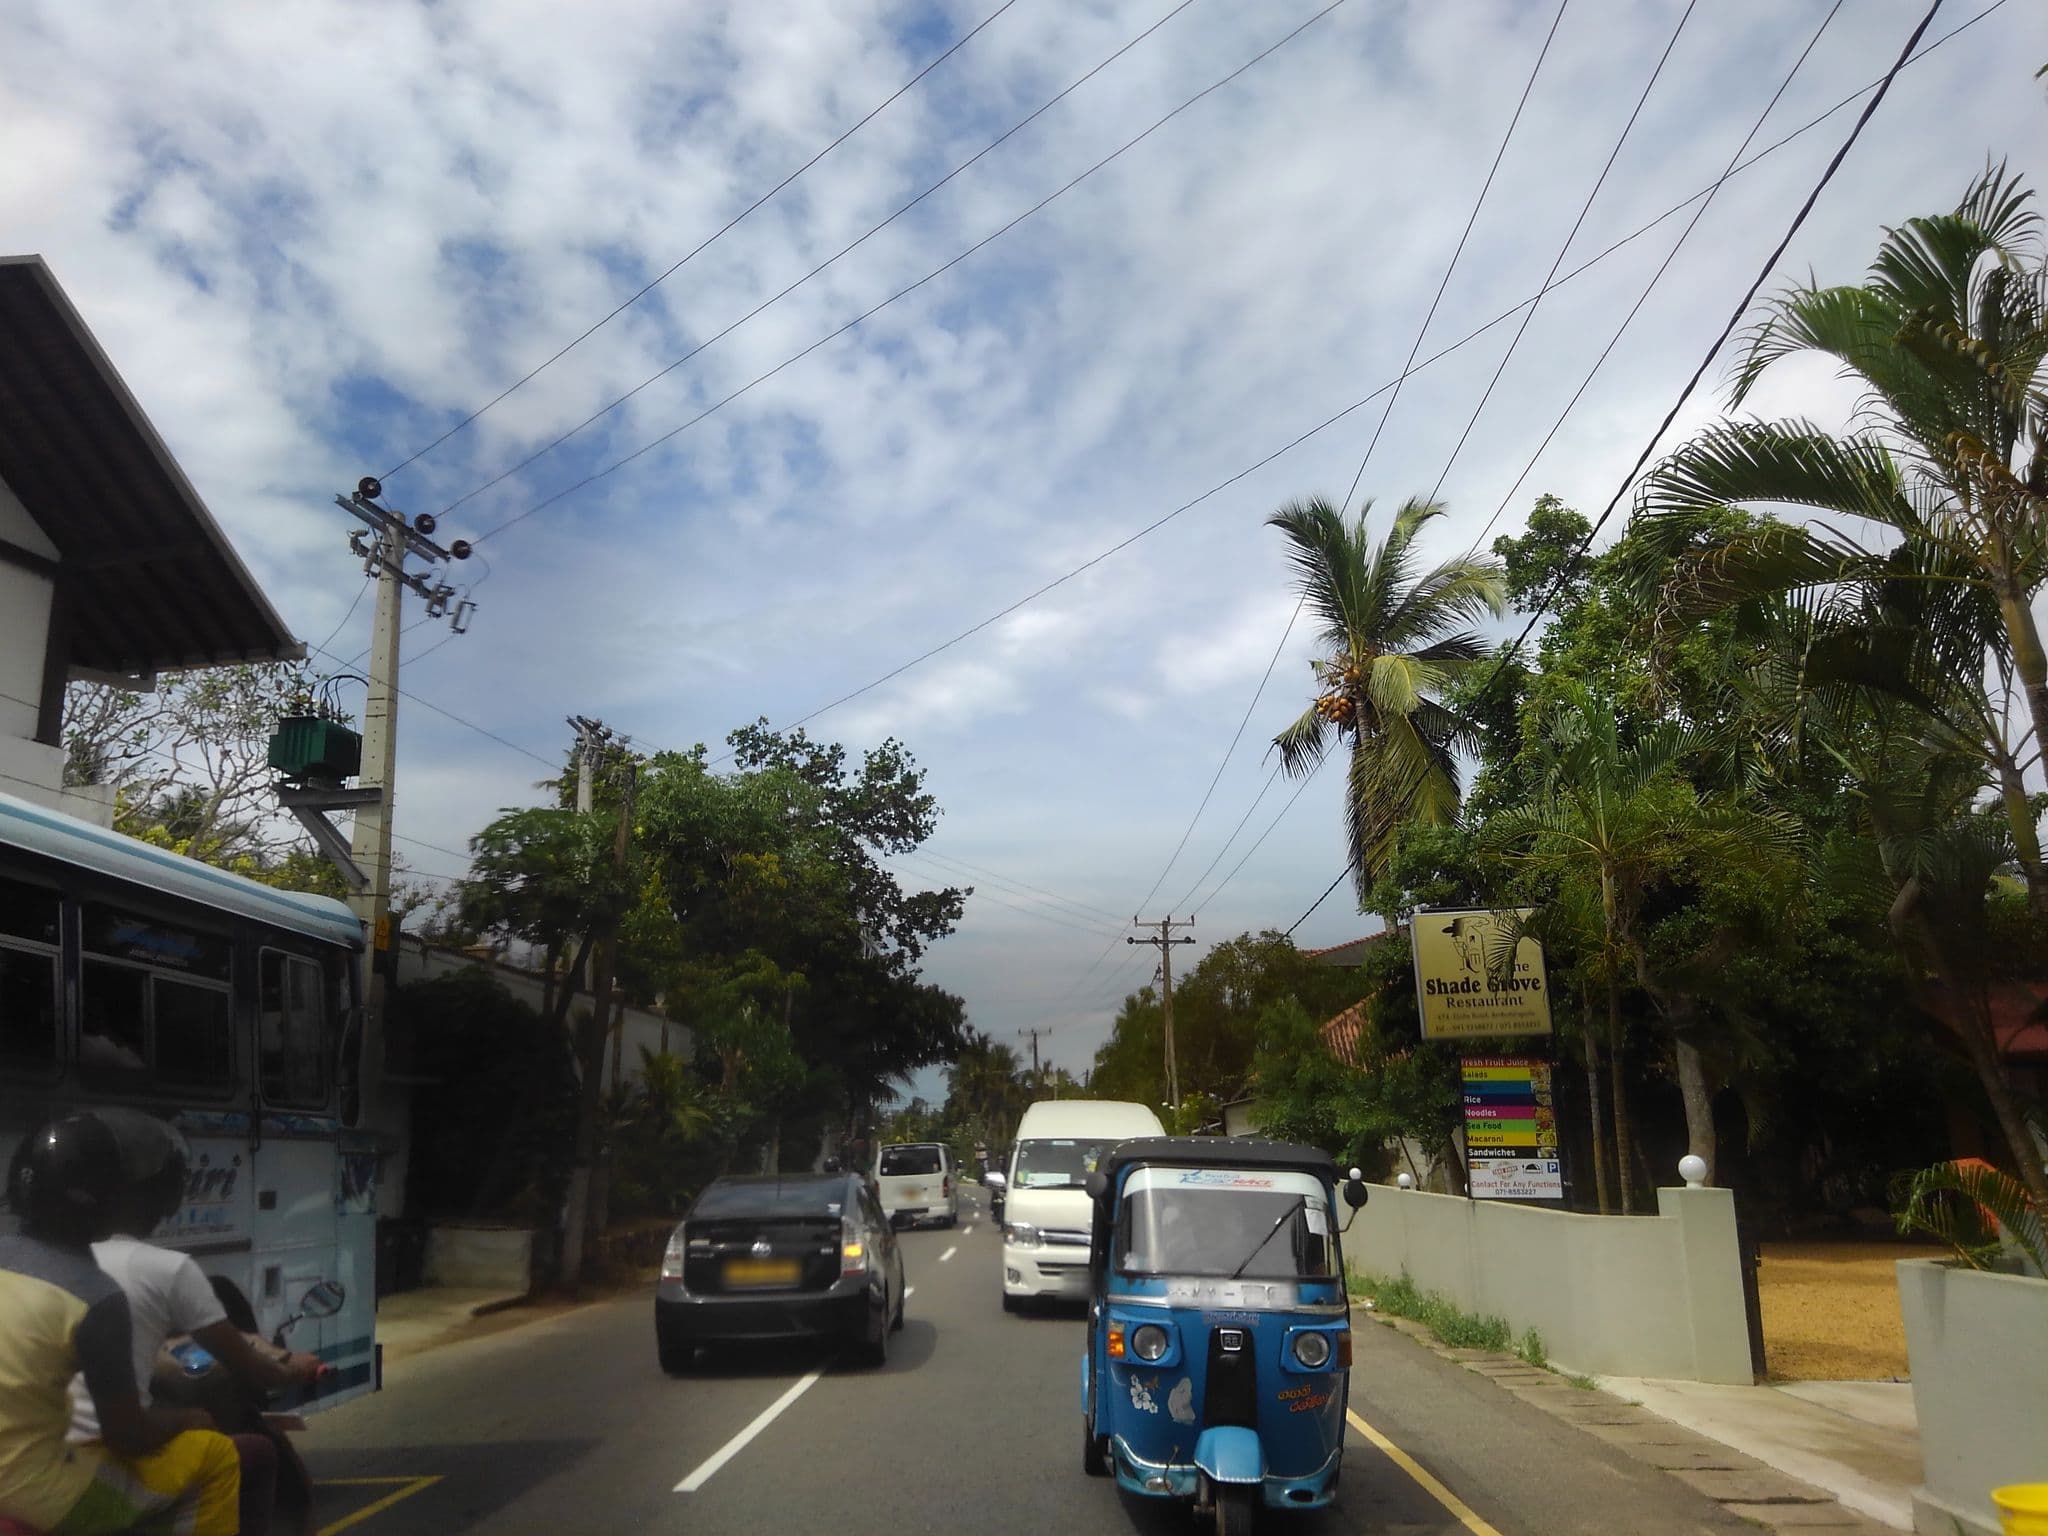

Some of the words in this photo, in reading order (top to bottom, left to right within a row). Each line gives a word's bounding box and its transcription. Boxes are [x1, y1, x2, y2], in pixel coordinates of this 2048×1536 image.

[1426, 977, 1481, 995] Shade
[1487, 976, 1541, 993] Grove
[1446, 996, 1524, 1009] Restaurant
[1485, 1058, 1504, 1067] Fruit
[1508, 1058, 1529, 1067] Juice
[1464, 1095, 1481, 1104] Rice
[1465, 1109, 1497, 1118] Noodles
[1466, 1121, 1481, 1130] Sea
[1483, 1121, 1502, 1130] Food
[1467, 1134, 1504, 1144] Macaroni
[1468, 1147, 1516, 1157] Sandwiches
[1471, 1180, 1499, 1189] Contact
[1500, 1180, 1511, 1189] For
[1513, 1180, 1526, 1191] Any
[1528, 1180, 1560, 1189] Functions
